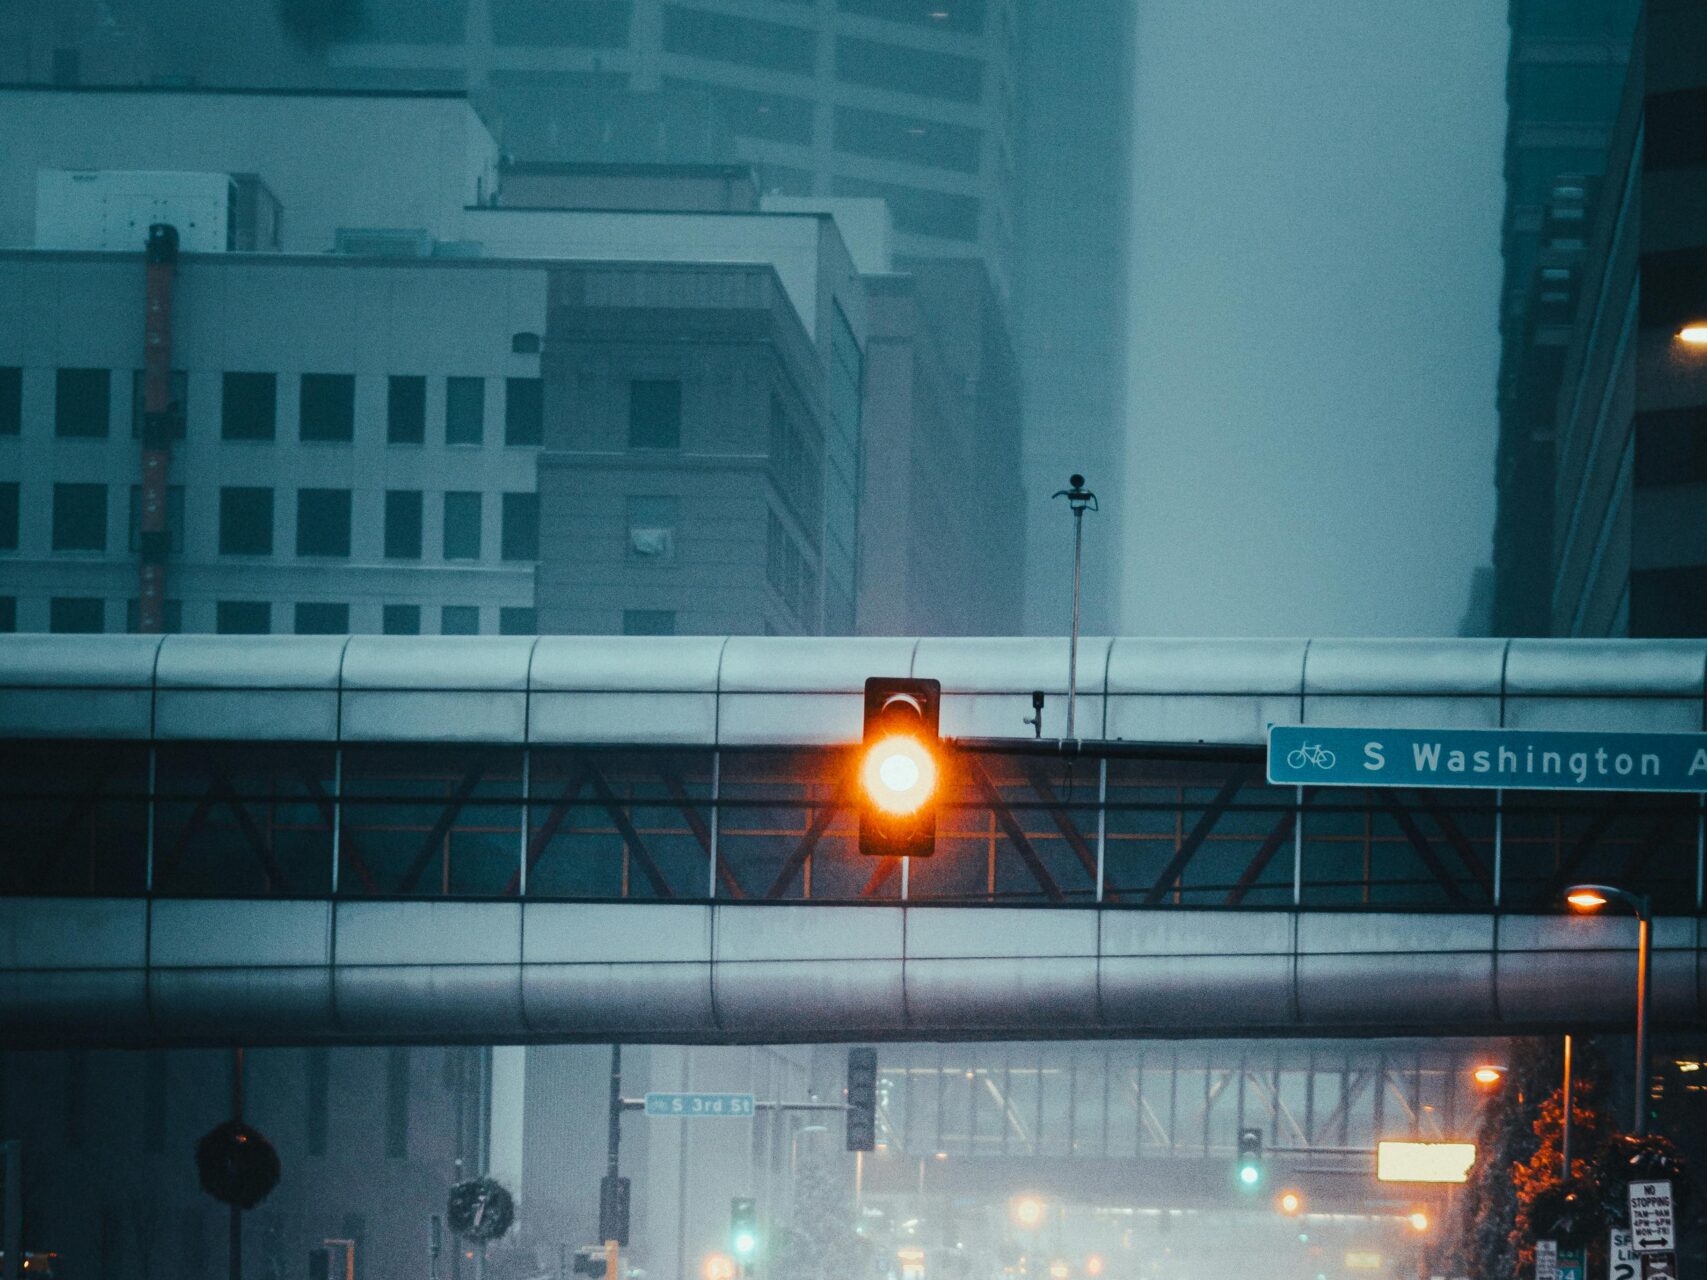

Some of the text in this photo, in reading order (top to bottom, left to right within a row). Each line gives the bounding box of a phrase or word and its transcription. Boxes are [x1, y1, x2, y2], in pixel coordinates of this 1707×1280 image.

[1363, 741, 1386, 771] S
[1412, 743, 1660, 784] Washington
[671, 1098, 750, 1112] S 3rd St
[1643, 1185, 1656, 1196] NO
[1631, 1196, 1670, 1208] STOPPING
